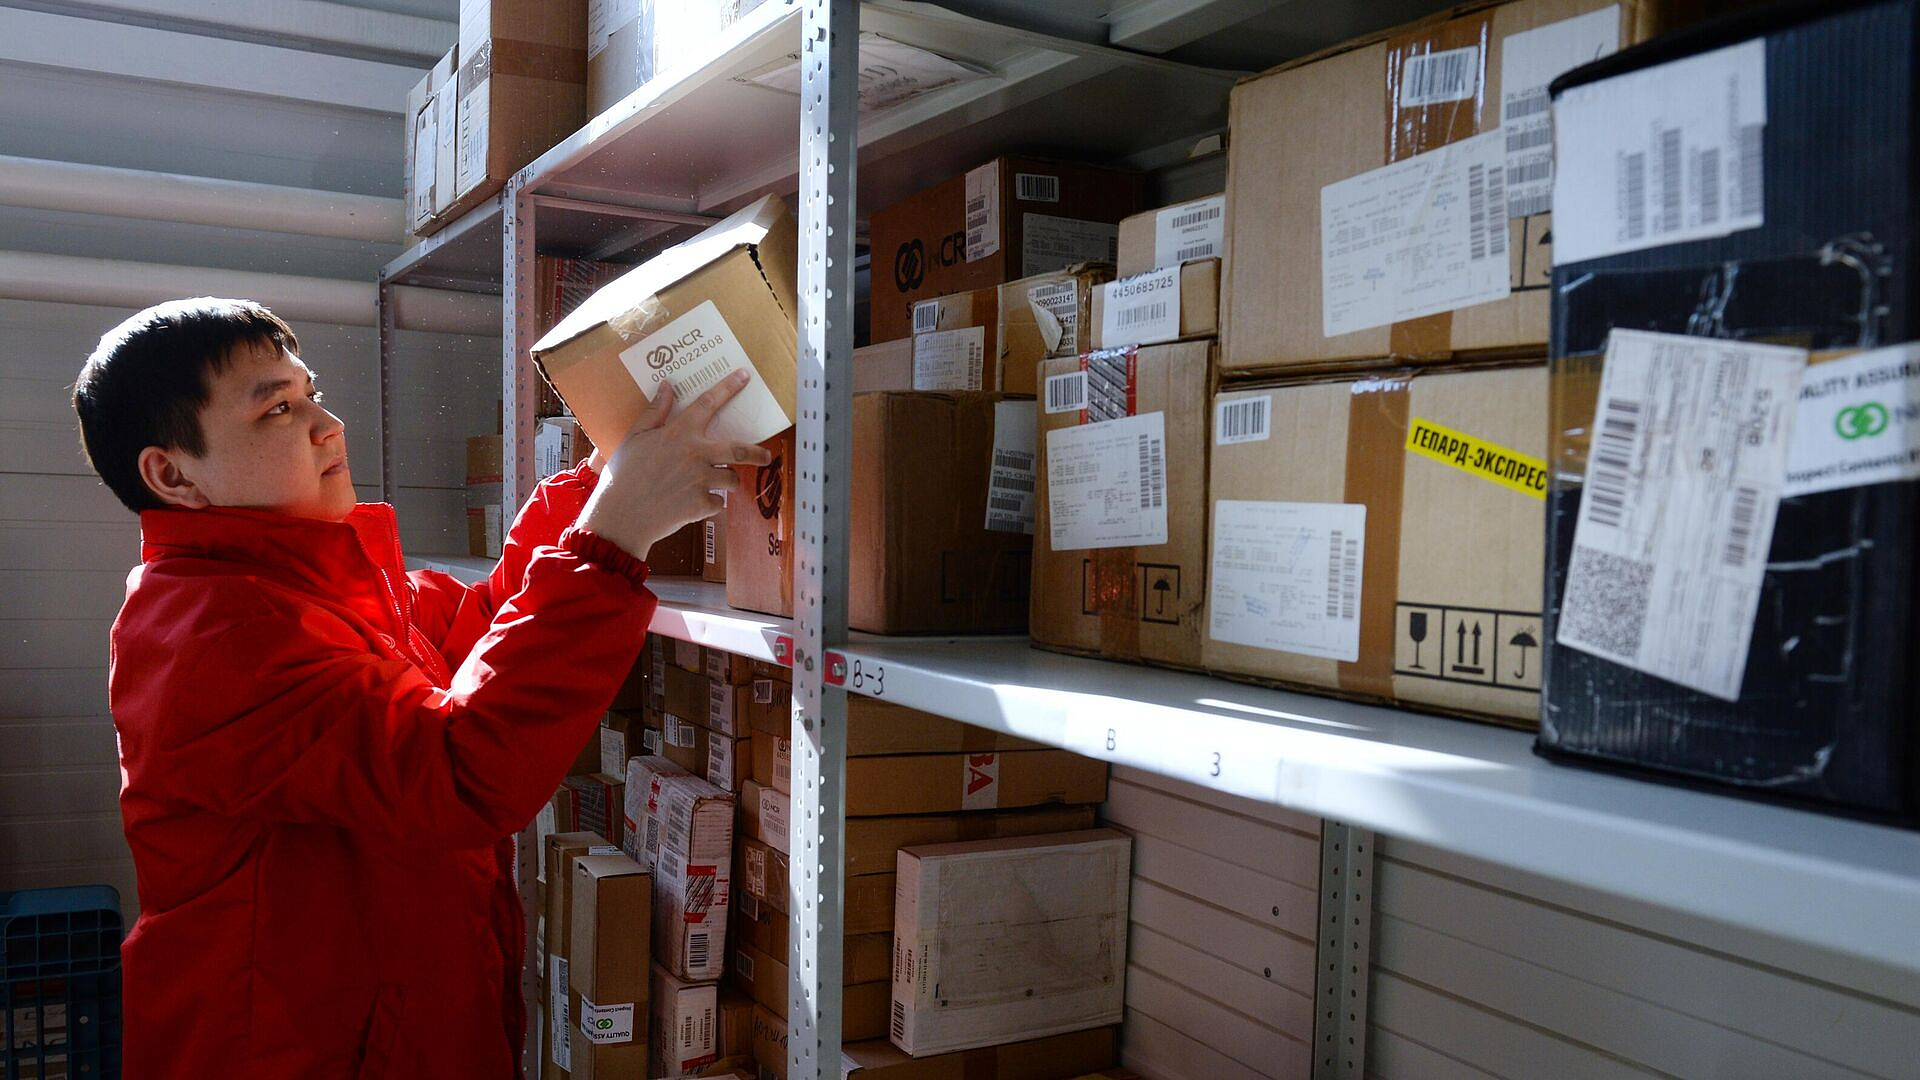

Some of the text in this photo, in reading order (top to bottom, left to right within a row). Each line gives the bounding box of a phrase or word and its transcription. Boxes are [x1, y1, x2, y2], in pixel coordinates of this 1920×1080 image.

[1035, 293, 1074, 309] 090023147
[1111, 275, 1174, 299] 4450685725
[671, 327, 705, 354] NCR
[650, 334, 725, 383] 0090022808
[1411, 424, 1547, 492] ГЕПАРД-ЭКСПРЕС
[851, 659, 886, 696] B-3
[1106, 728, 1222, 777] B 3
[606, 1030, 631, 1039] QUALITY
